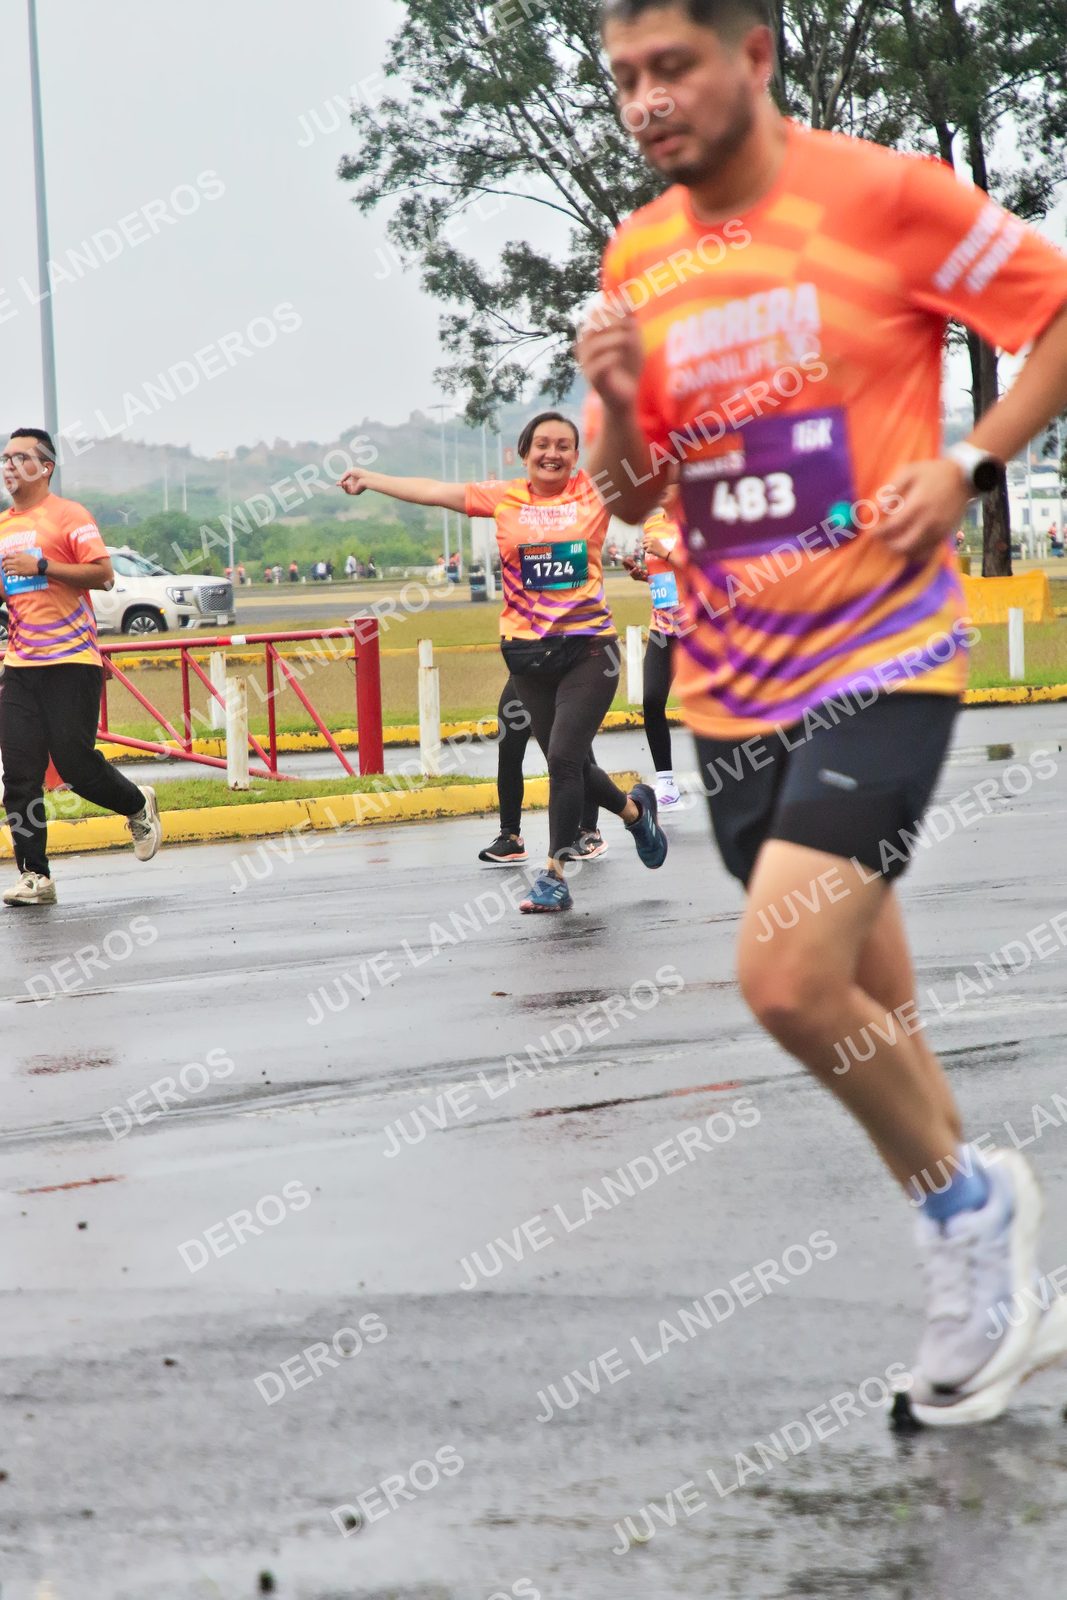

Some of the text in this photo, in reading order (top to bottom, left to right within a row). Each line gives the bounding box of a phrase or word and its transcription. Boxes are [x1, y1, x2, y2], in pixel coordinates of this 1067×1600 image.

[711, 472, 795, 525] 483
[570, 543, 583, 555] 10K
[532, 560, 574, 577] 1724
